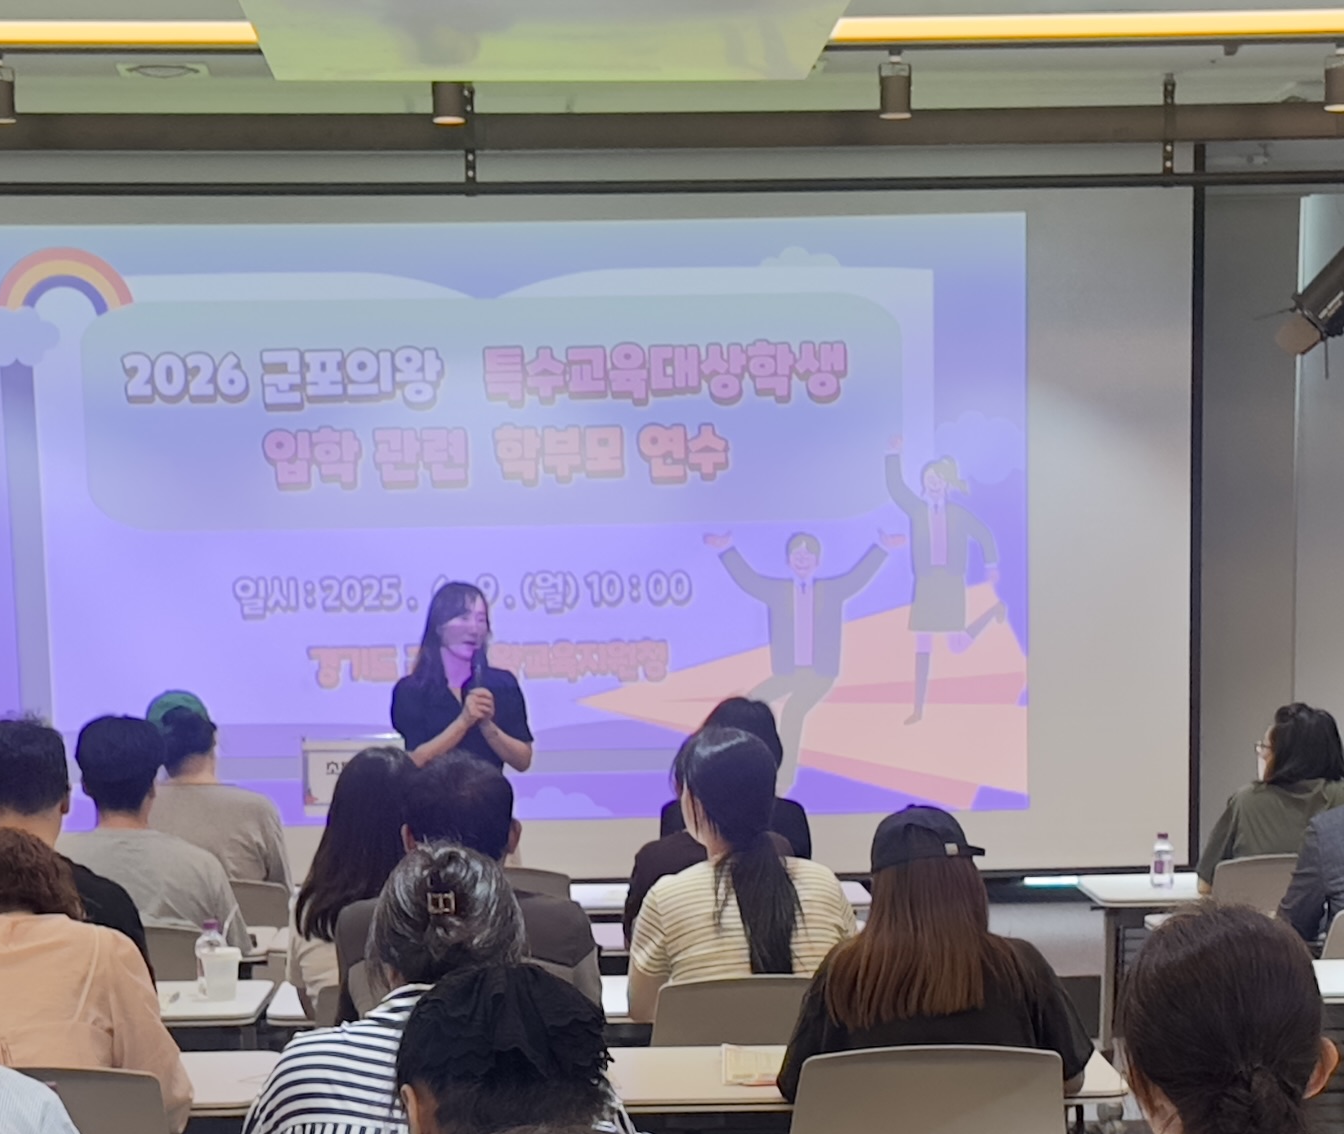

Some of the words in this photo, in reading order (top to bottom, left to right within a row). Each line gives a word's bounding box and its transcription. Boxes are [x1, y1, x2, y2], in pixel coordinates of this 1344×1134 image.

[121, 351, 250, 404] 2026
[260, 345, 445, 412] 군포의왕
[483, 339, 848, 409] 특수교육대상학생
[261, 425, 362, 491] 입학
[372, 426, 469, 489] 관련
[493, 423, 625, 487] 학부모
[636, 422, 729, 484] 연수
[306, 643, 398, 690] 경기도
